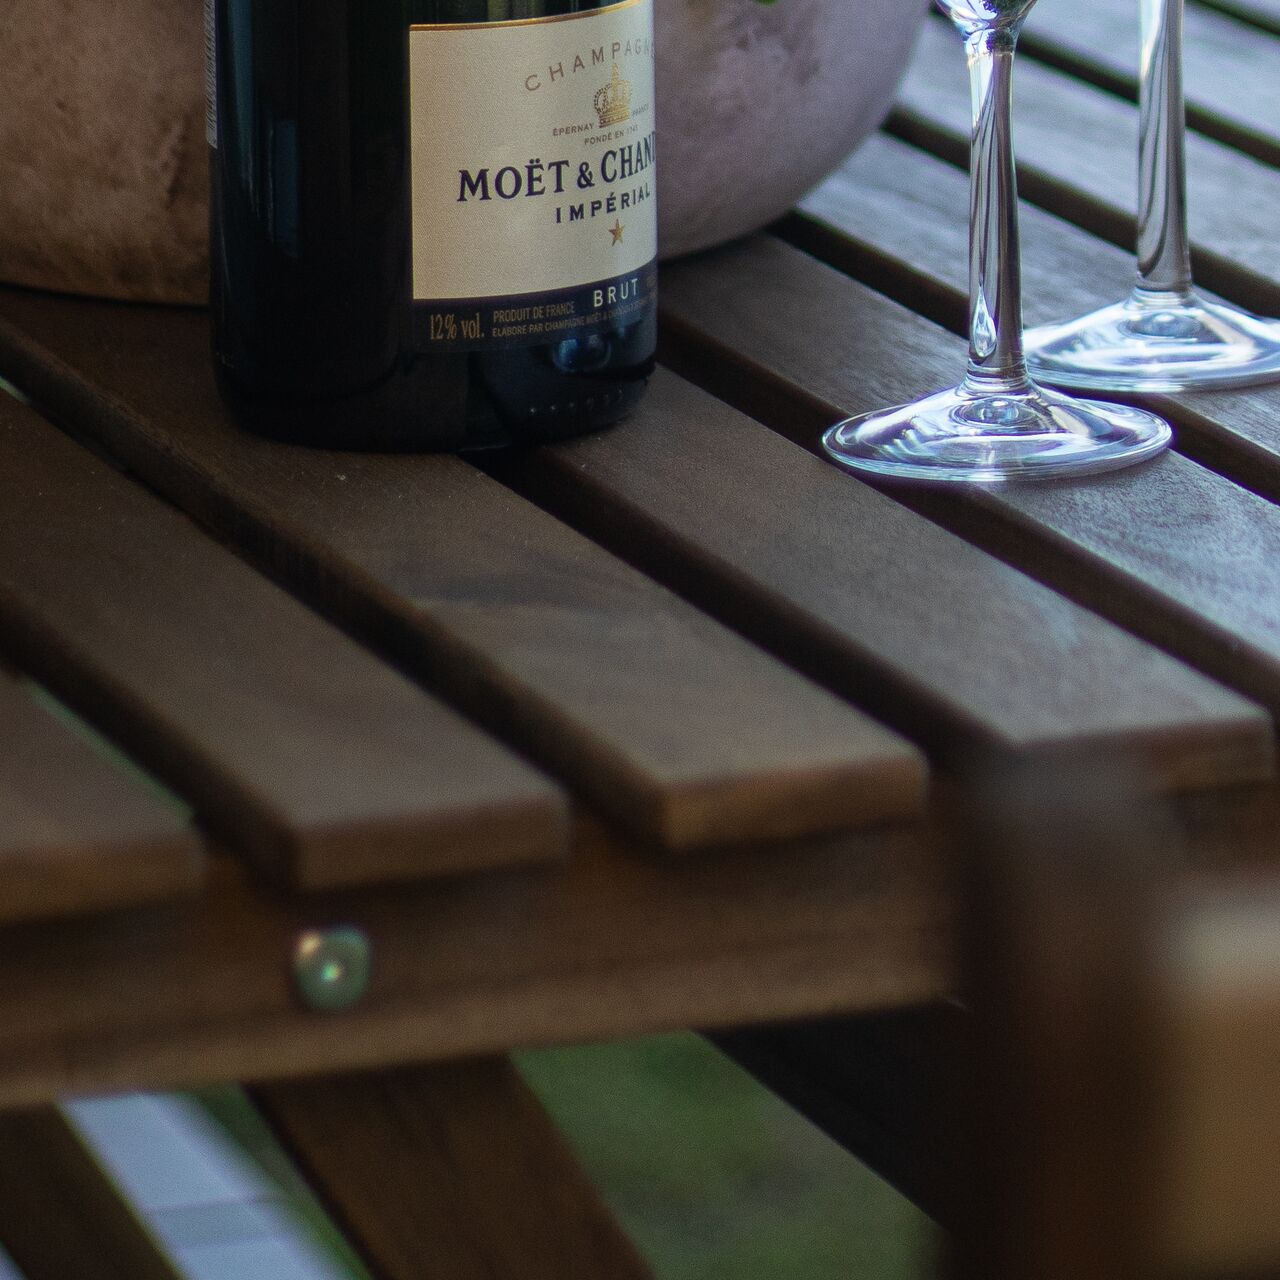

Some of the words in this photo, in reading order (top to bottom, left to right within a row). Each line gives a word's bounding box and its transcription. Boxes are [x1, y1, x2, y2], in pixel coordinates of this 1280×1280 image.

[457, 158, 570, 202] MOËT
[577, 161, 595, 190] &
[555, 182, 651, 224] IMPÉRIAL
[593, 278, 638, 308] BRUT
[430, 313, 457, 340] 12%
[460, 312, 485, 339] vol.
[493, 307, 530, 323] PRODUIT
[532, 306, 545, 319] DE
[546, 301, 575, 317] FRANCE
[529, 322, 543, 333] PAR
